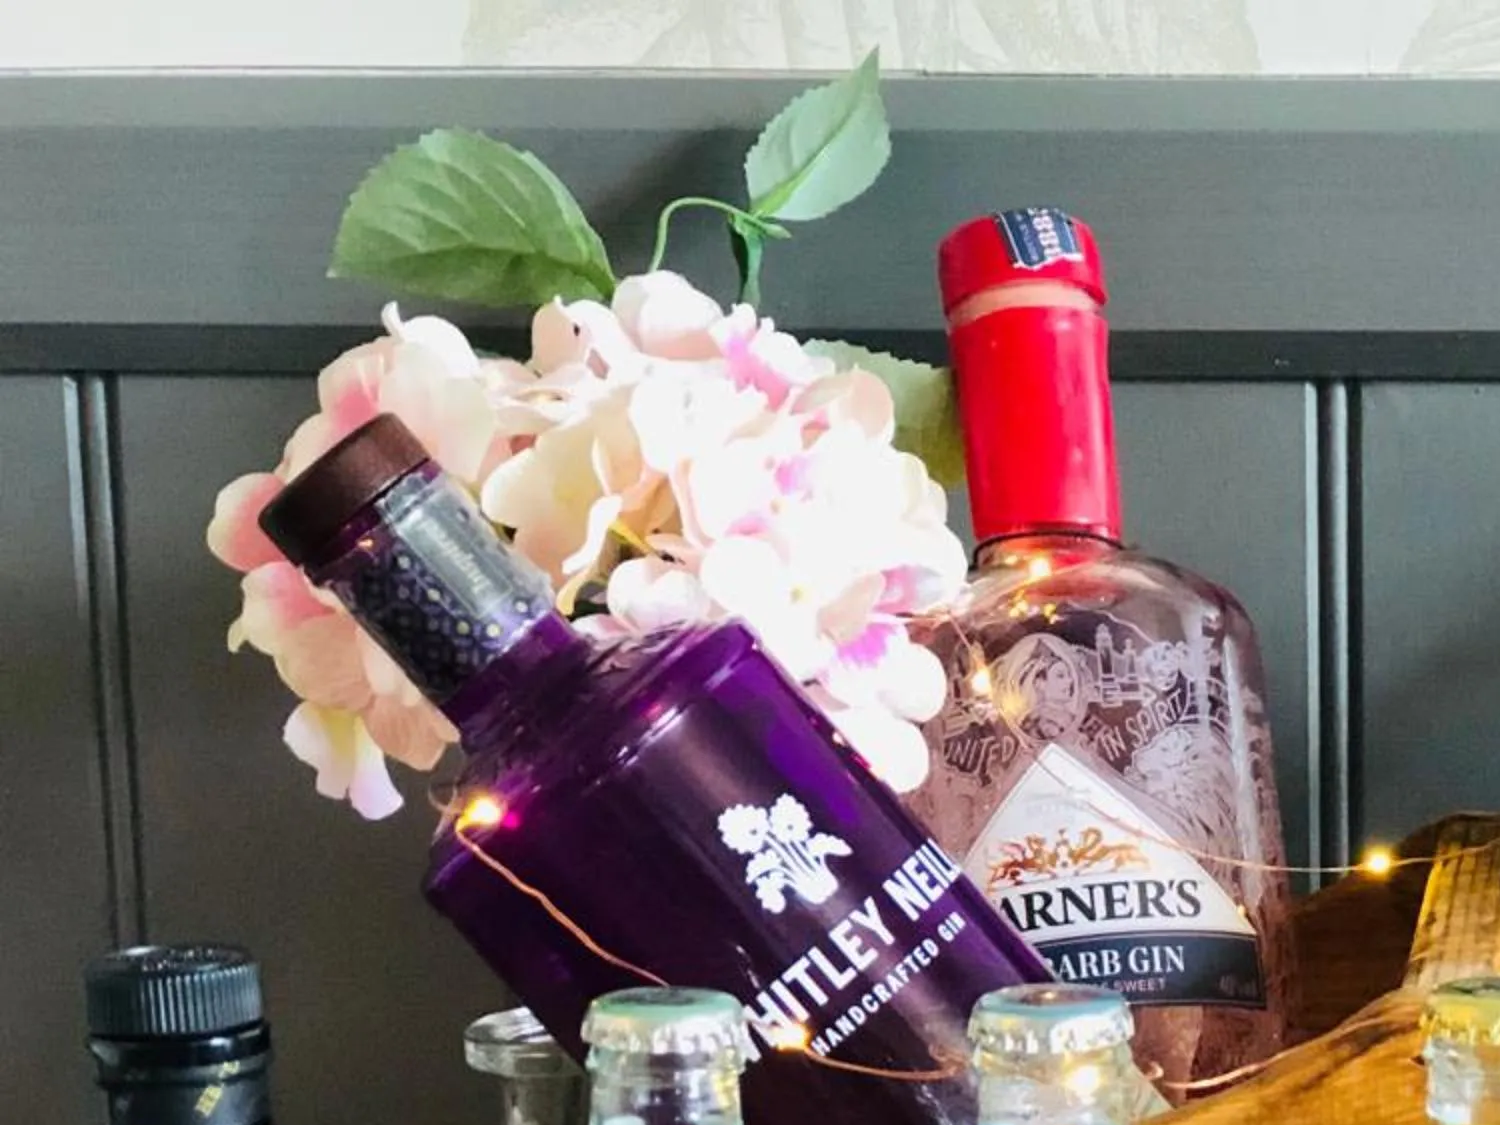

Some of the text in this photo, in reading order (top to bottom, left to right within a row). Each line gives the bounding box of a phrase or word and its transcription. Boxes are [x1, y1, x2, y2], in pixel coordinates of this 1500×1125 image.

[999, 878, 1202, 933] ARNER'S
[1128, 944, 1185, 977] GIN
[809, 911, 967, 1057] HANDCRAFTED GIN
[1114, 977, 1166, 993] SWEET
